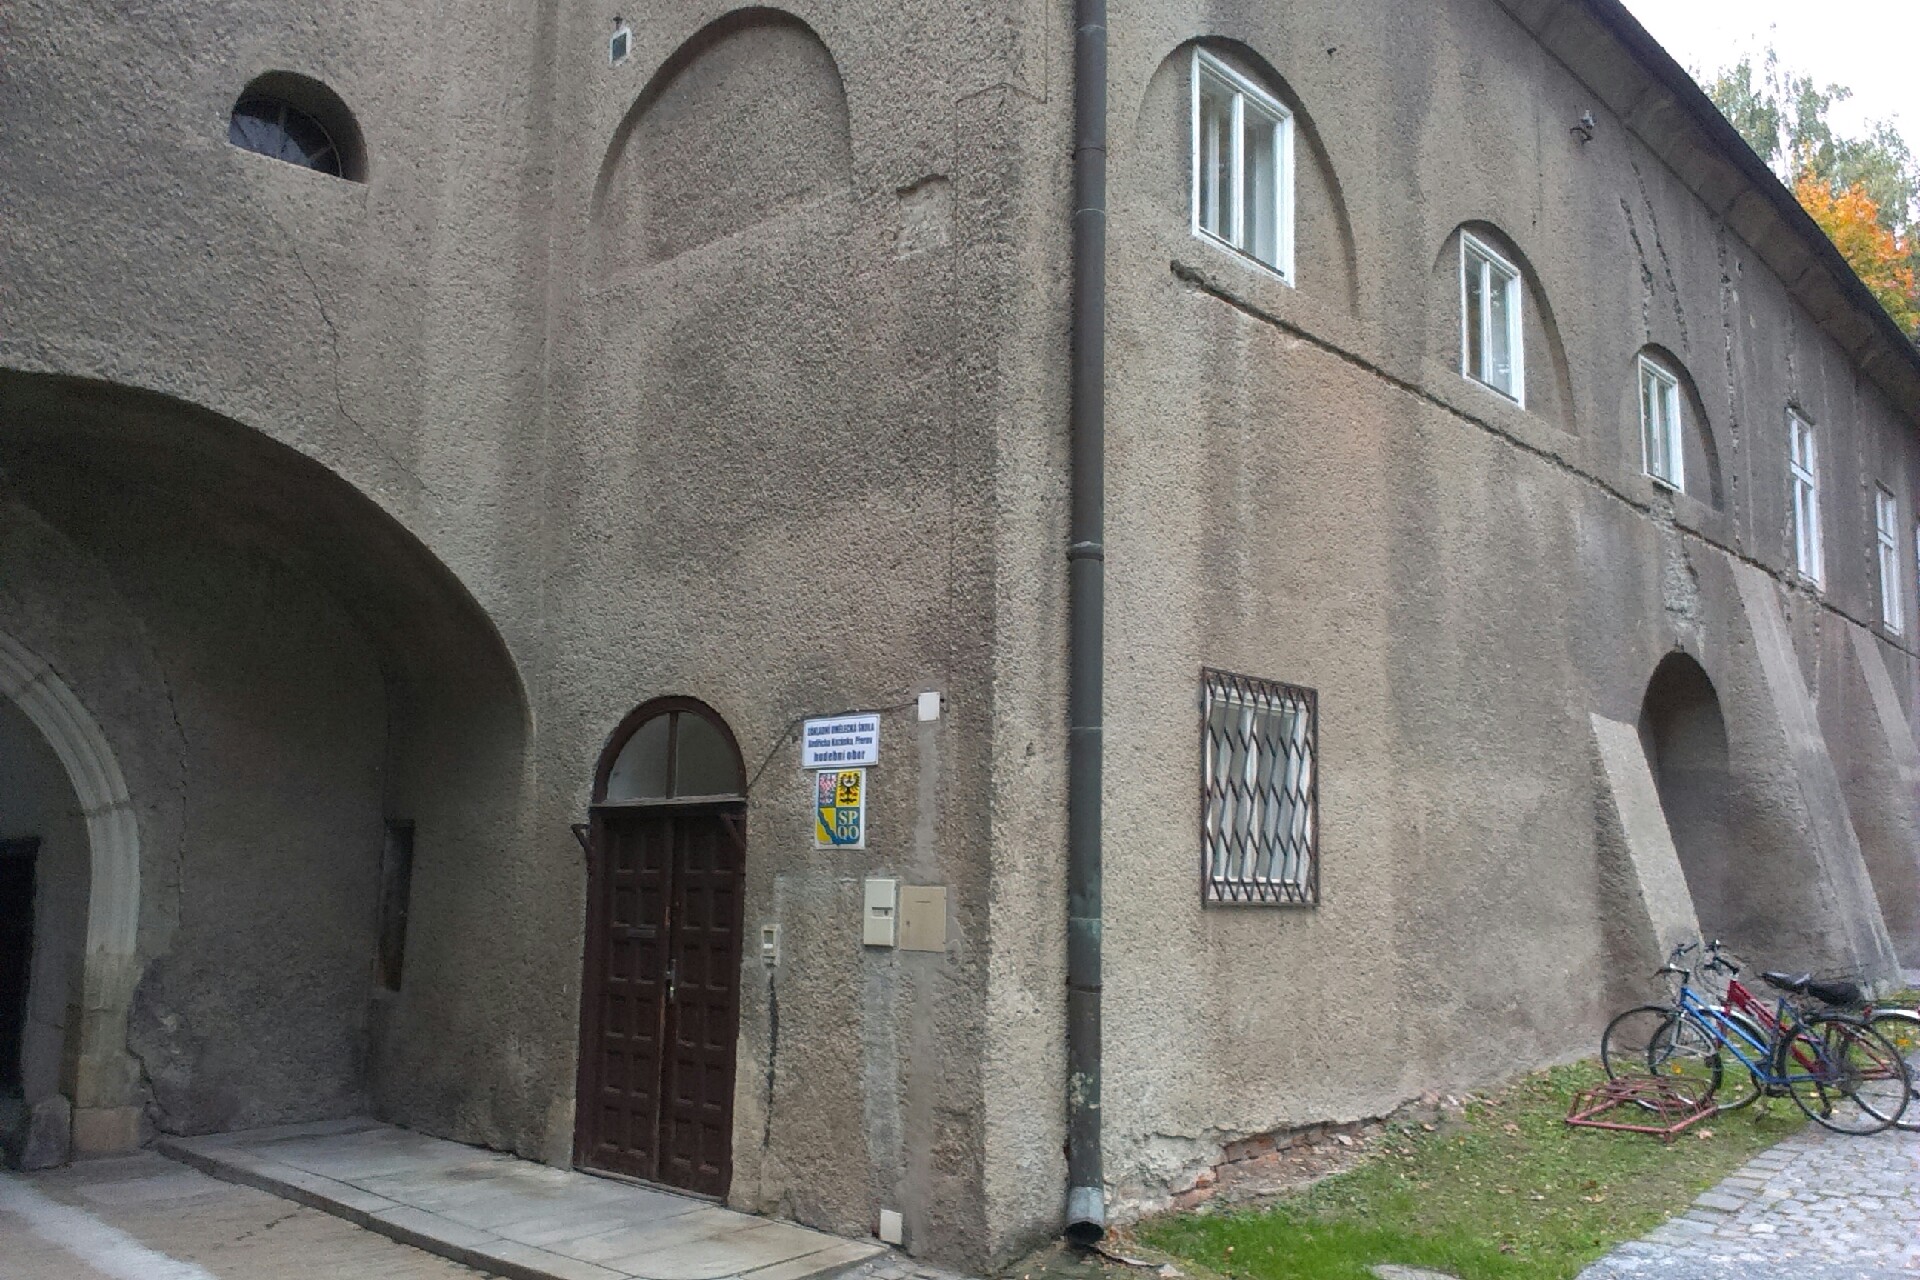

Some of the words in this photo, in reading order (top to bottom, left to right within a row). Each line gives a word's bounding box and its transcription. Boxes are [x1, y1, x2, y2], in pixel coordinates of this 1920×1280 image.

[814, 750, 845, 762] hudební
[847, 750, 865, 760] obor
[838, 810, 858, 825] SP
